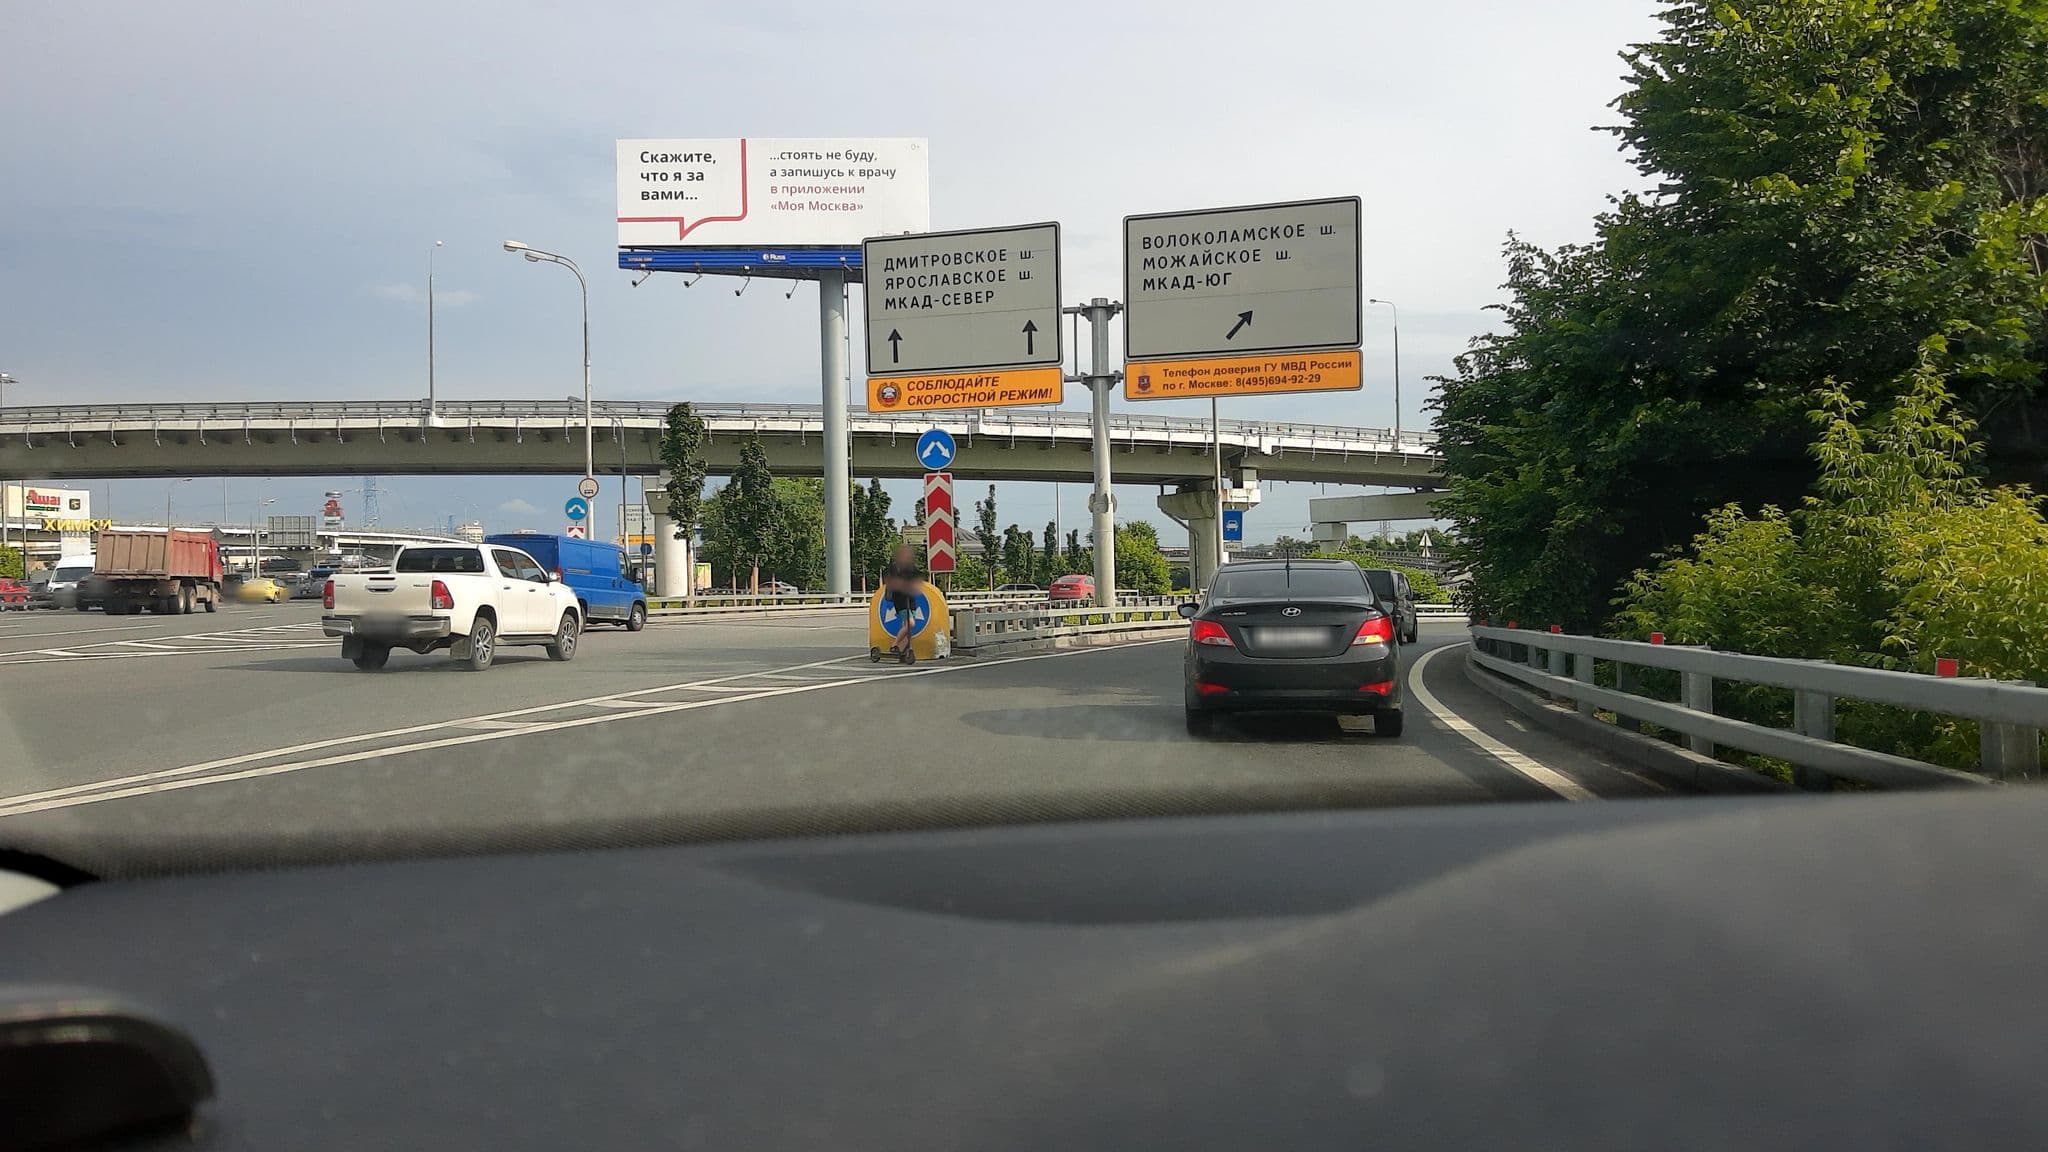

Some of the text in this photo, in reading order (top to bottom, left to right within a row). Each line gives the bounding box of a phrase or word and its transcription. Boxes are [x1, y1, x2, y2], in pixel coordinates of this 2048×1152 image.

[641, 151, 715, 164] Скажите,
[827, 152, 841, 160] не
[641, 172, 704, 181] что я за
[770, 168, 896, 179] а запишусь к врачу
[771, 186, 864, 196] в приложении
[771, 201, 863, 211] «Моя Москва»
[1143, 224, 1336, 249] ВОЛОКОЛАМСКОЕ ш.
[884, 249, 1034, 272] ДМИТРОВСКОЕ ш.
[1143, 248, 1291, 270] МОЖАЙСКОЕ ш.
[885, 269, 1033, 290] ЯРОСЛАВСКОЕ ш.
[1143, 273, 1232, 291] МКАД-ЮГ
[885, 290, 995, 310] МКАД-СЕВЕР
[1163, 361, 1351, 378] Телефон доверия ГУ МВД России
[907, 376, 1000, 391] СОБЛЮДАЙТЕ
[1189, 378, 1232, 389] Москве:
[1235, 374, 1322, 387] 8(495)694-92-29
[908, 388, 1053, 406] СКОРОСТНОЙ РЕЖИМ!
[43, 519, 112, 531] ХИМКИ
